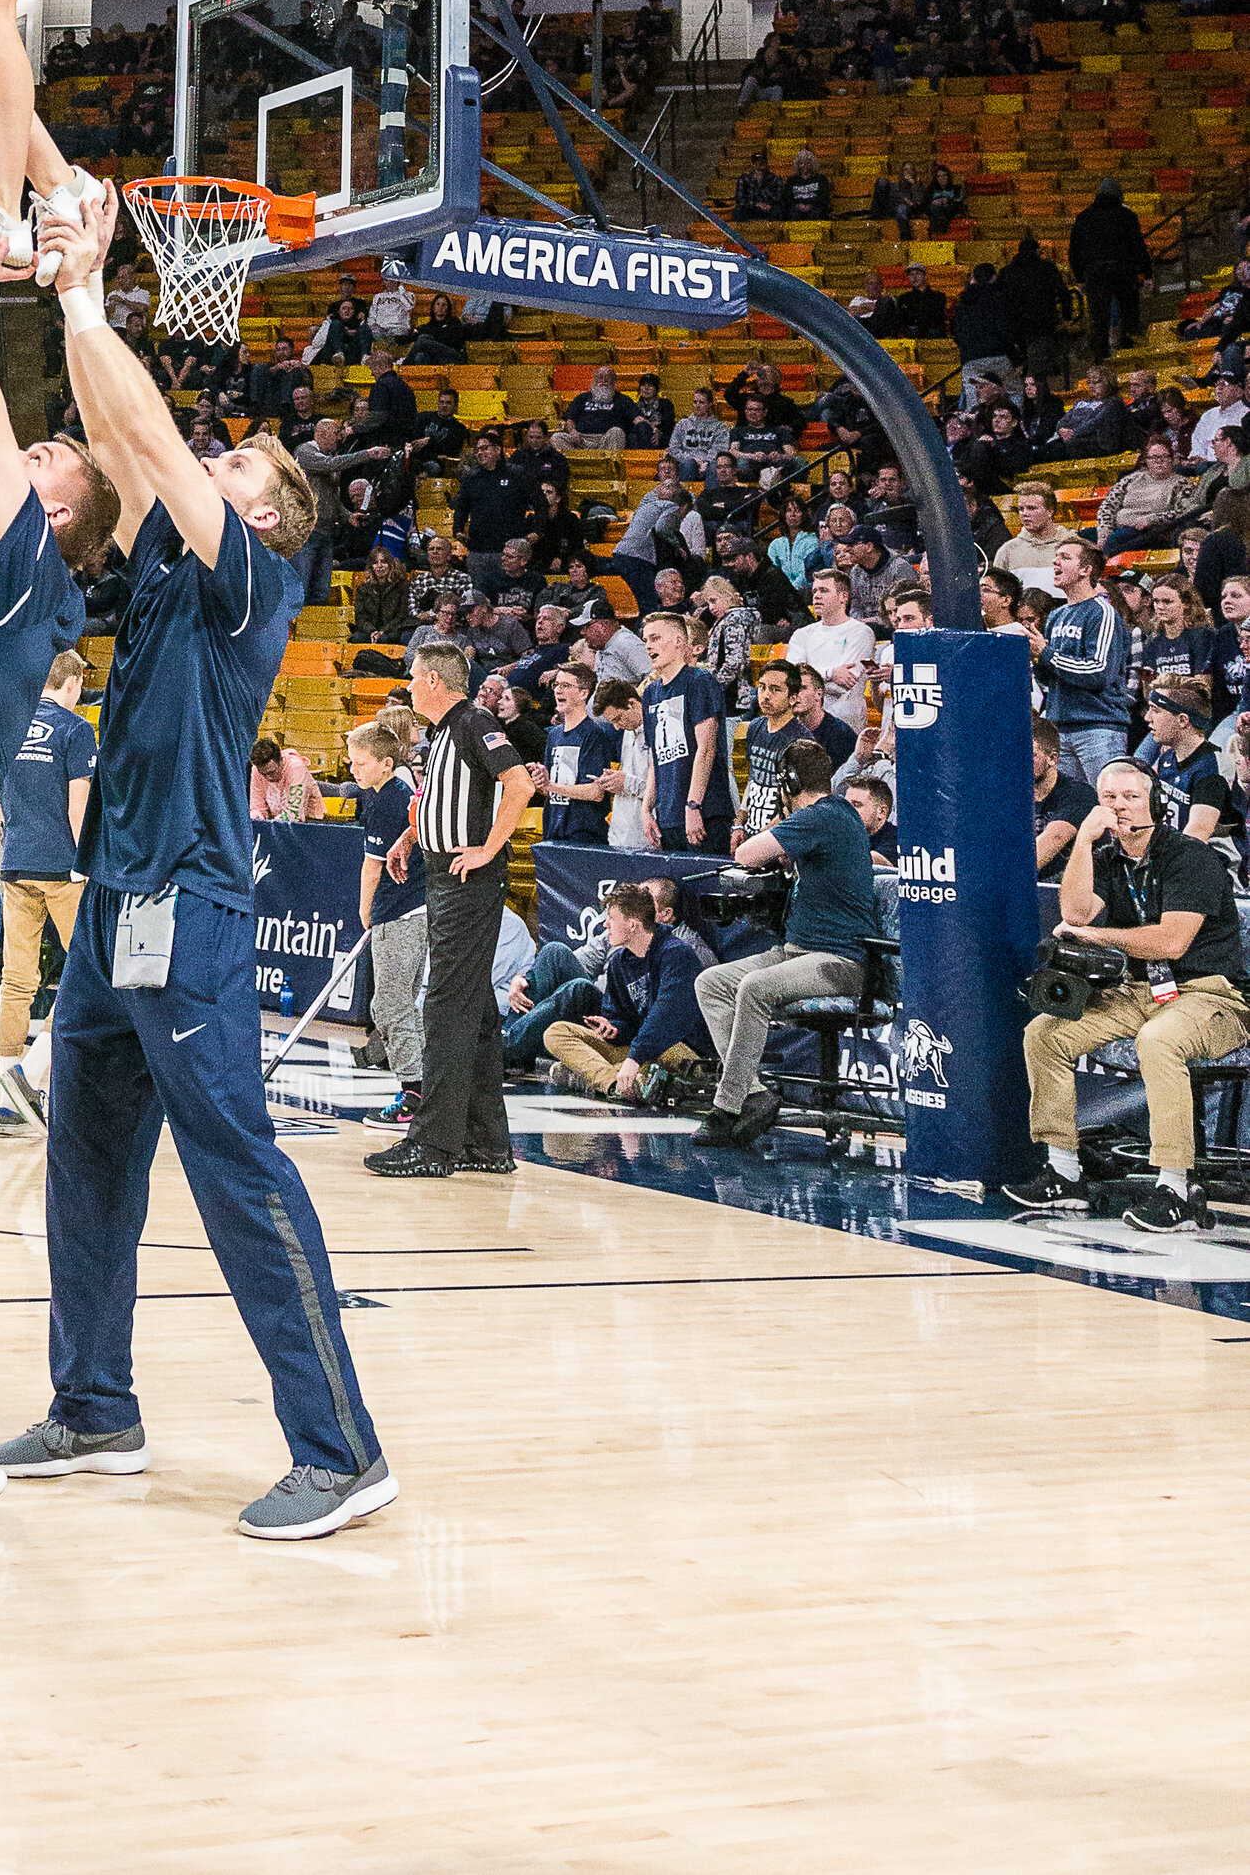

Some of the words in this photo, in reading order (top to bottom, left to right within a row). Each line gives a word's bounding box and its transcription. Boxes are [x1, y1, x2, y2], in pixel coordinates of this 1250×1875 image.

[432, 231, 620, 290] AMERICA
[626, 252, 739, 302] FIRST
[897, 882, 957, 904] rtgage
